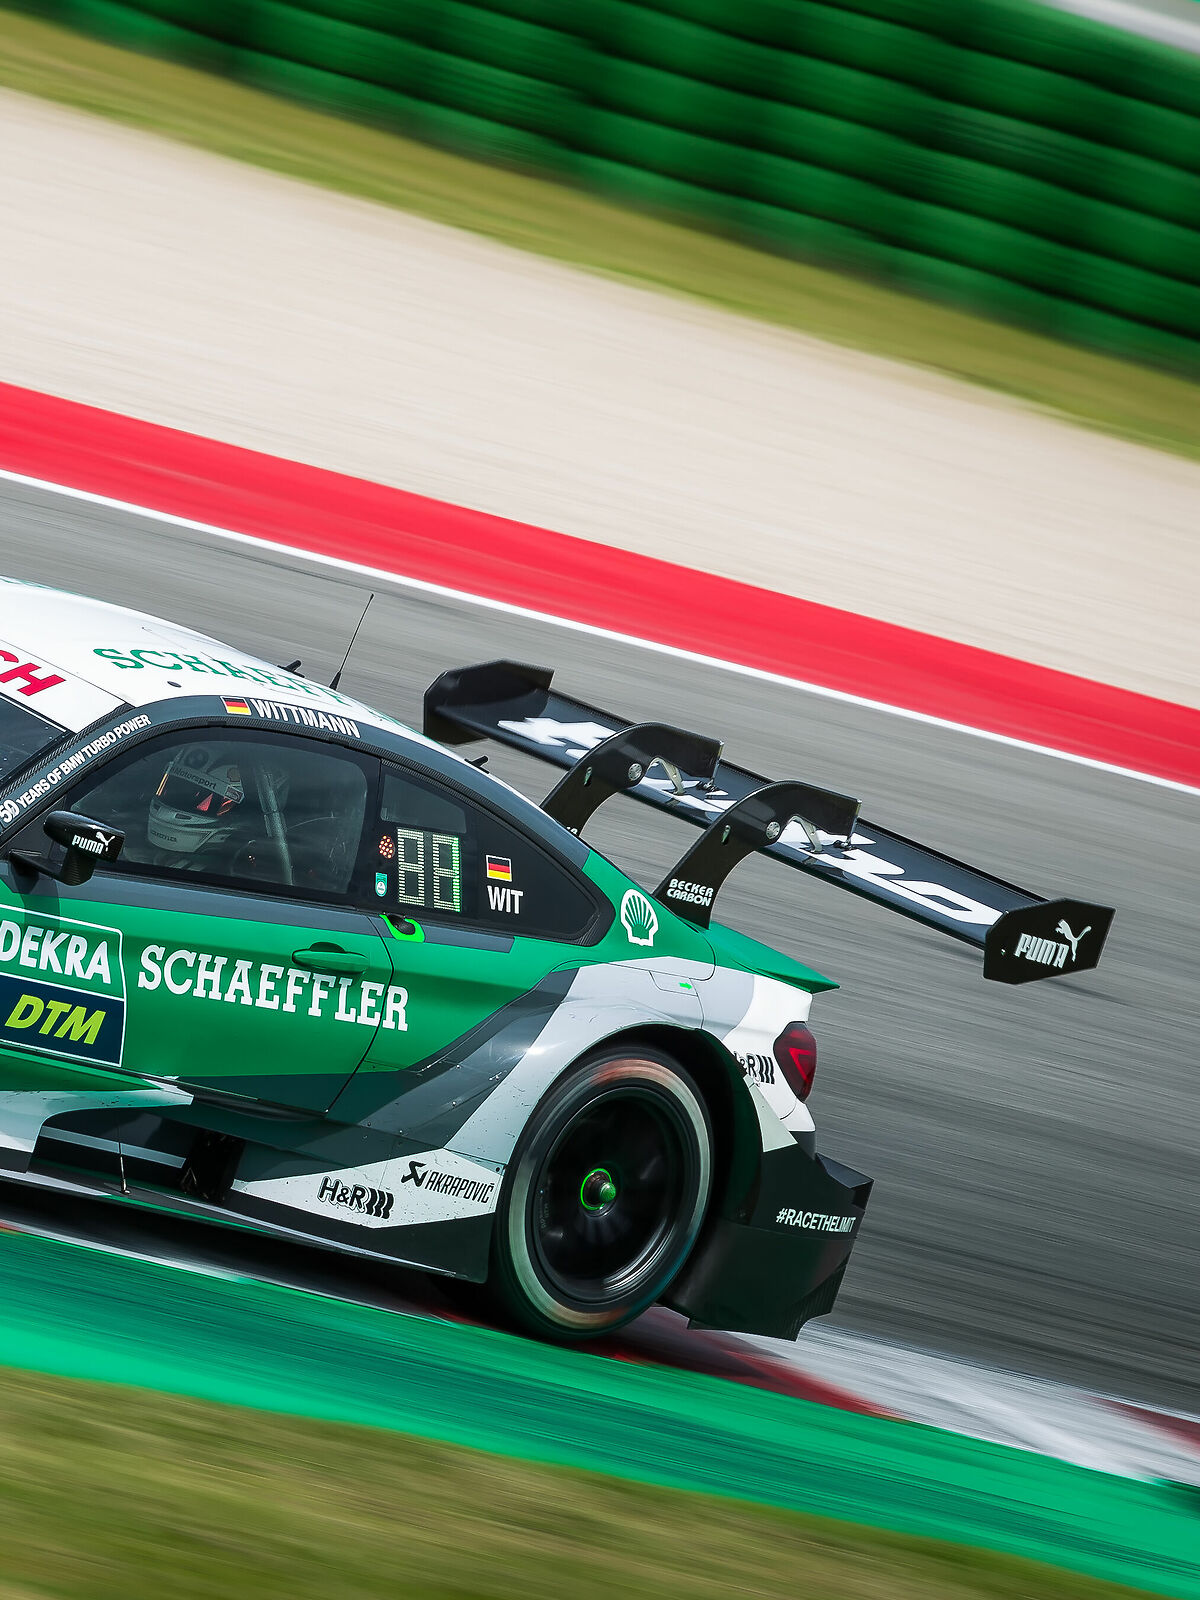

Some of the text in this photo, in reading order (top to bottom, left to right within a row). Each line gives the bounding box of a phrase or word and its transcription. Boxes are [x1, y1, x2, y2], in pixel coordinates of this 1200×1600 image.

[250, 698, 361, 739] WITTMANN
[16, 777, 51, 809] YEARS
[46, 767, 64, 786] OF
[60, 750, 87, 777] BMW
[84, 730, 117, 759] TURBO
[113, 714, 152, 740] POWER
[71, 834, 104, 853] PUMA
[487, 884, 524, 915] WIT
[666, 888, 712, 907] CARBON
[669, 878, 714, 897] BECKER
[1014, 931, 1070, 969] PUMA
[137, 944, 409, 1032] SCHAEFFLER
[5, 994, 106, 1046] DTM
[317, 1176, 368, 1210] H&R
[425, 1171, 495, 1204] AKRAPOVIČ
